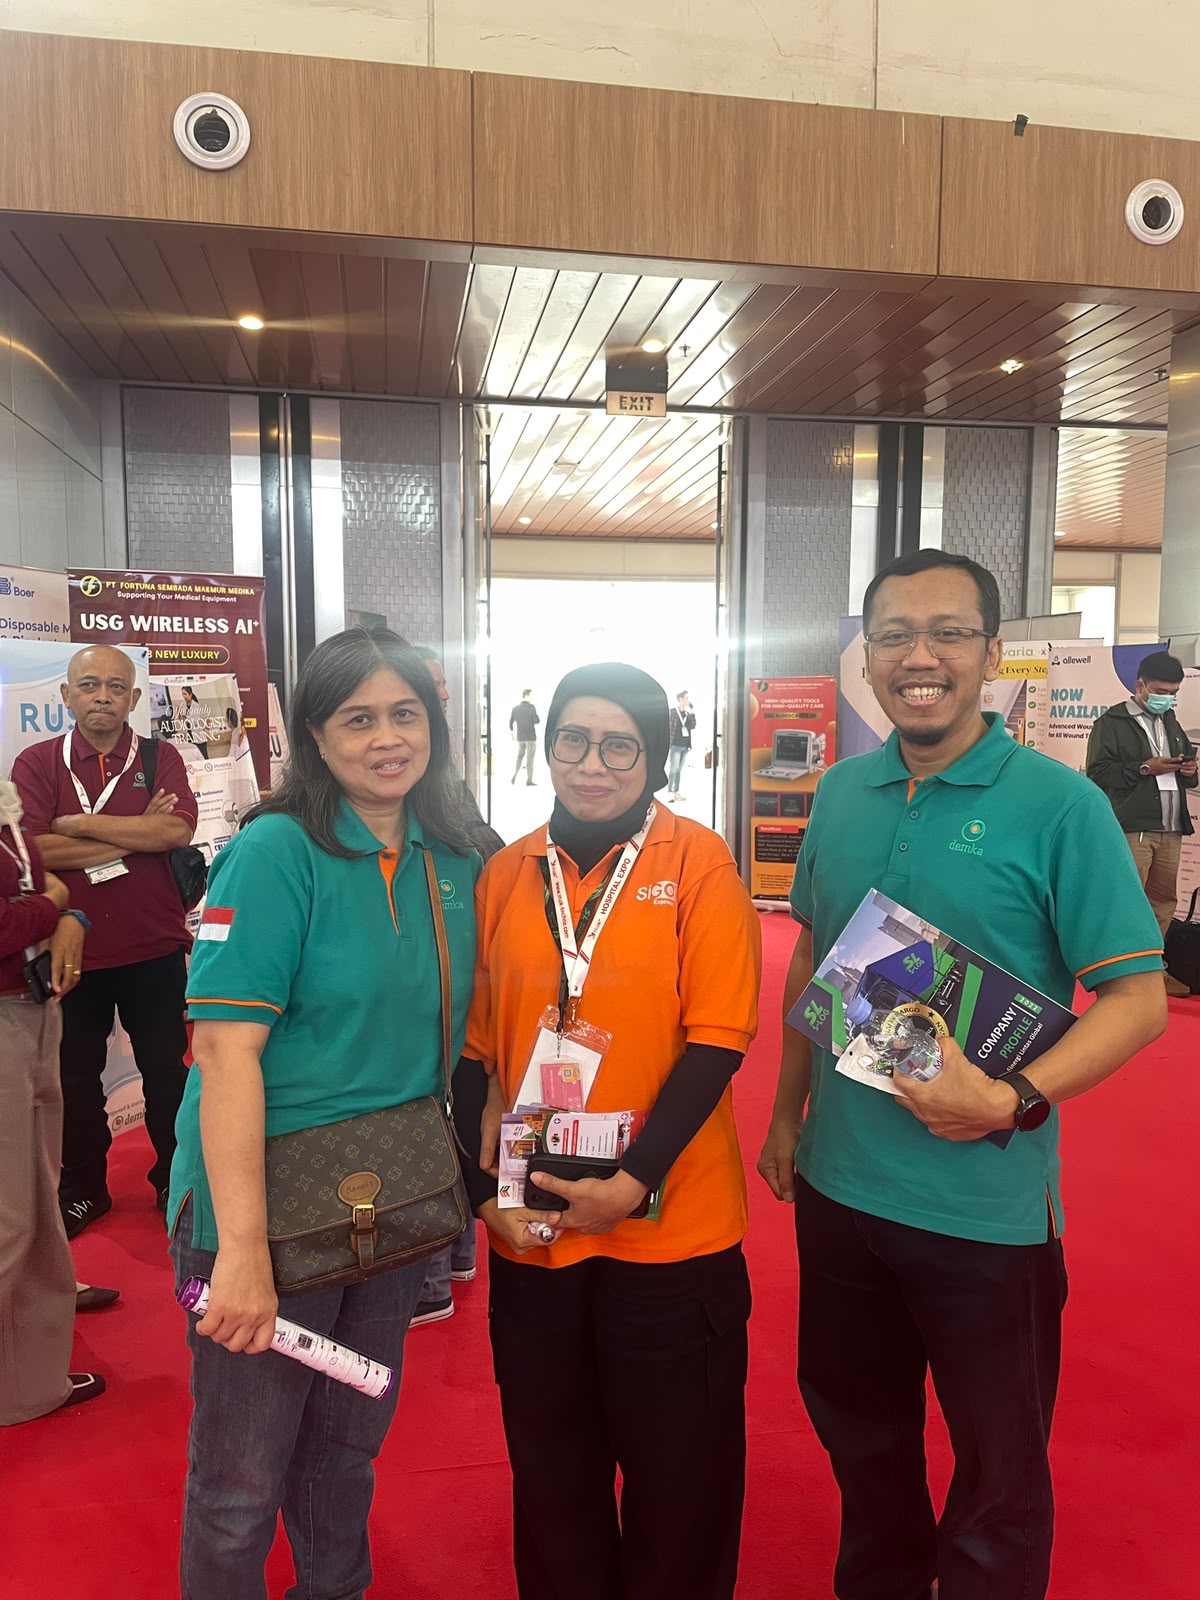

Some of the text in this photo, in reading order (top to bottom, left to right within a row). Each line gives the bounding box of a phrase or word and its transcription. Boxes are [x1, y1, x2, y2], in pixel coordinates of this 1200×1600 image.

[619, 395, 654, 411] EXIT
[14, 587, 35, 597] Boer
[120, 582, 155, 590] FORTUNA
[157, 584, 193, 592] SEMBADA
[194, 586, 226, 594] MAKMUR
[117, 591, 156, 600] Supporting
[202, 595, 237, 603] Equipment
[0, 618, 59, 633] Disposable
[80, 613, 124, 631] USG
[130, 615, 229, 634] WIRELESS
[155, 650, 179, 659] NEW
[181, 651, 220, 660] LUXURY
[1063, 656, 1091, 664] allewell
[1006, 667, 1030, 676] Every
[1050, 688, 1084, 701] NOW
[160, 716, 226, 732] AUDIOLOGIST
[171, 729, 221, 744] TRAINING
[949, 839, 983, 856] demka
[600, 858, 631, 915] HOSPITAL EXPO
[1020, 997, 1038, 1011] 2022
[812, 1008, 830, 1031] S-LOG
[978, 1007, 1017, 1059] COMPANY
[1000, 1017, 1032, 1058] PROFILE
[1019, 1039, 1032, 1056] Lintas
[1029, 1022, 1044, 1040] Global
